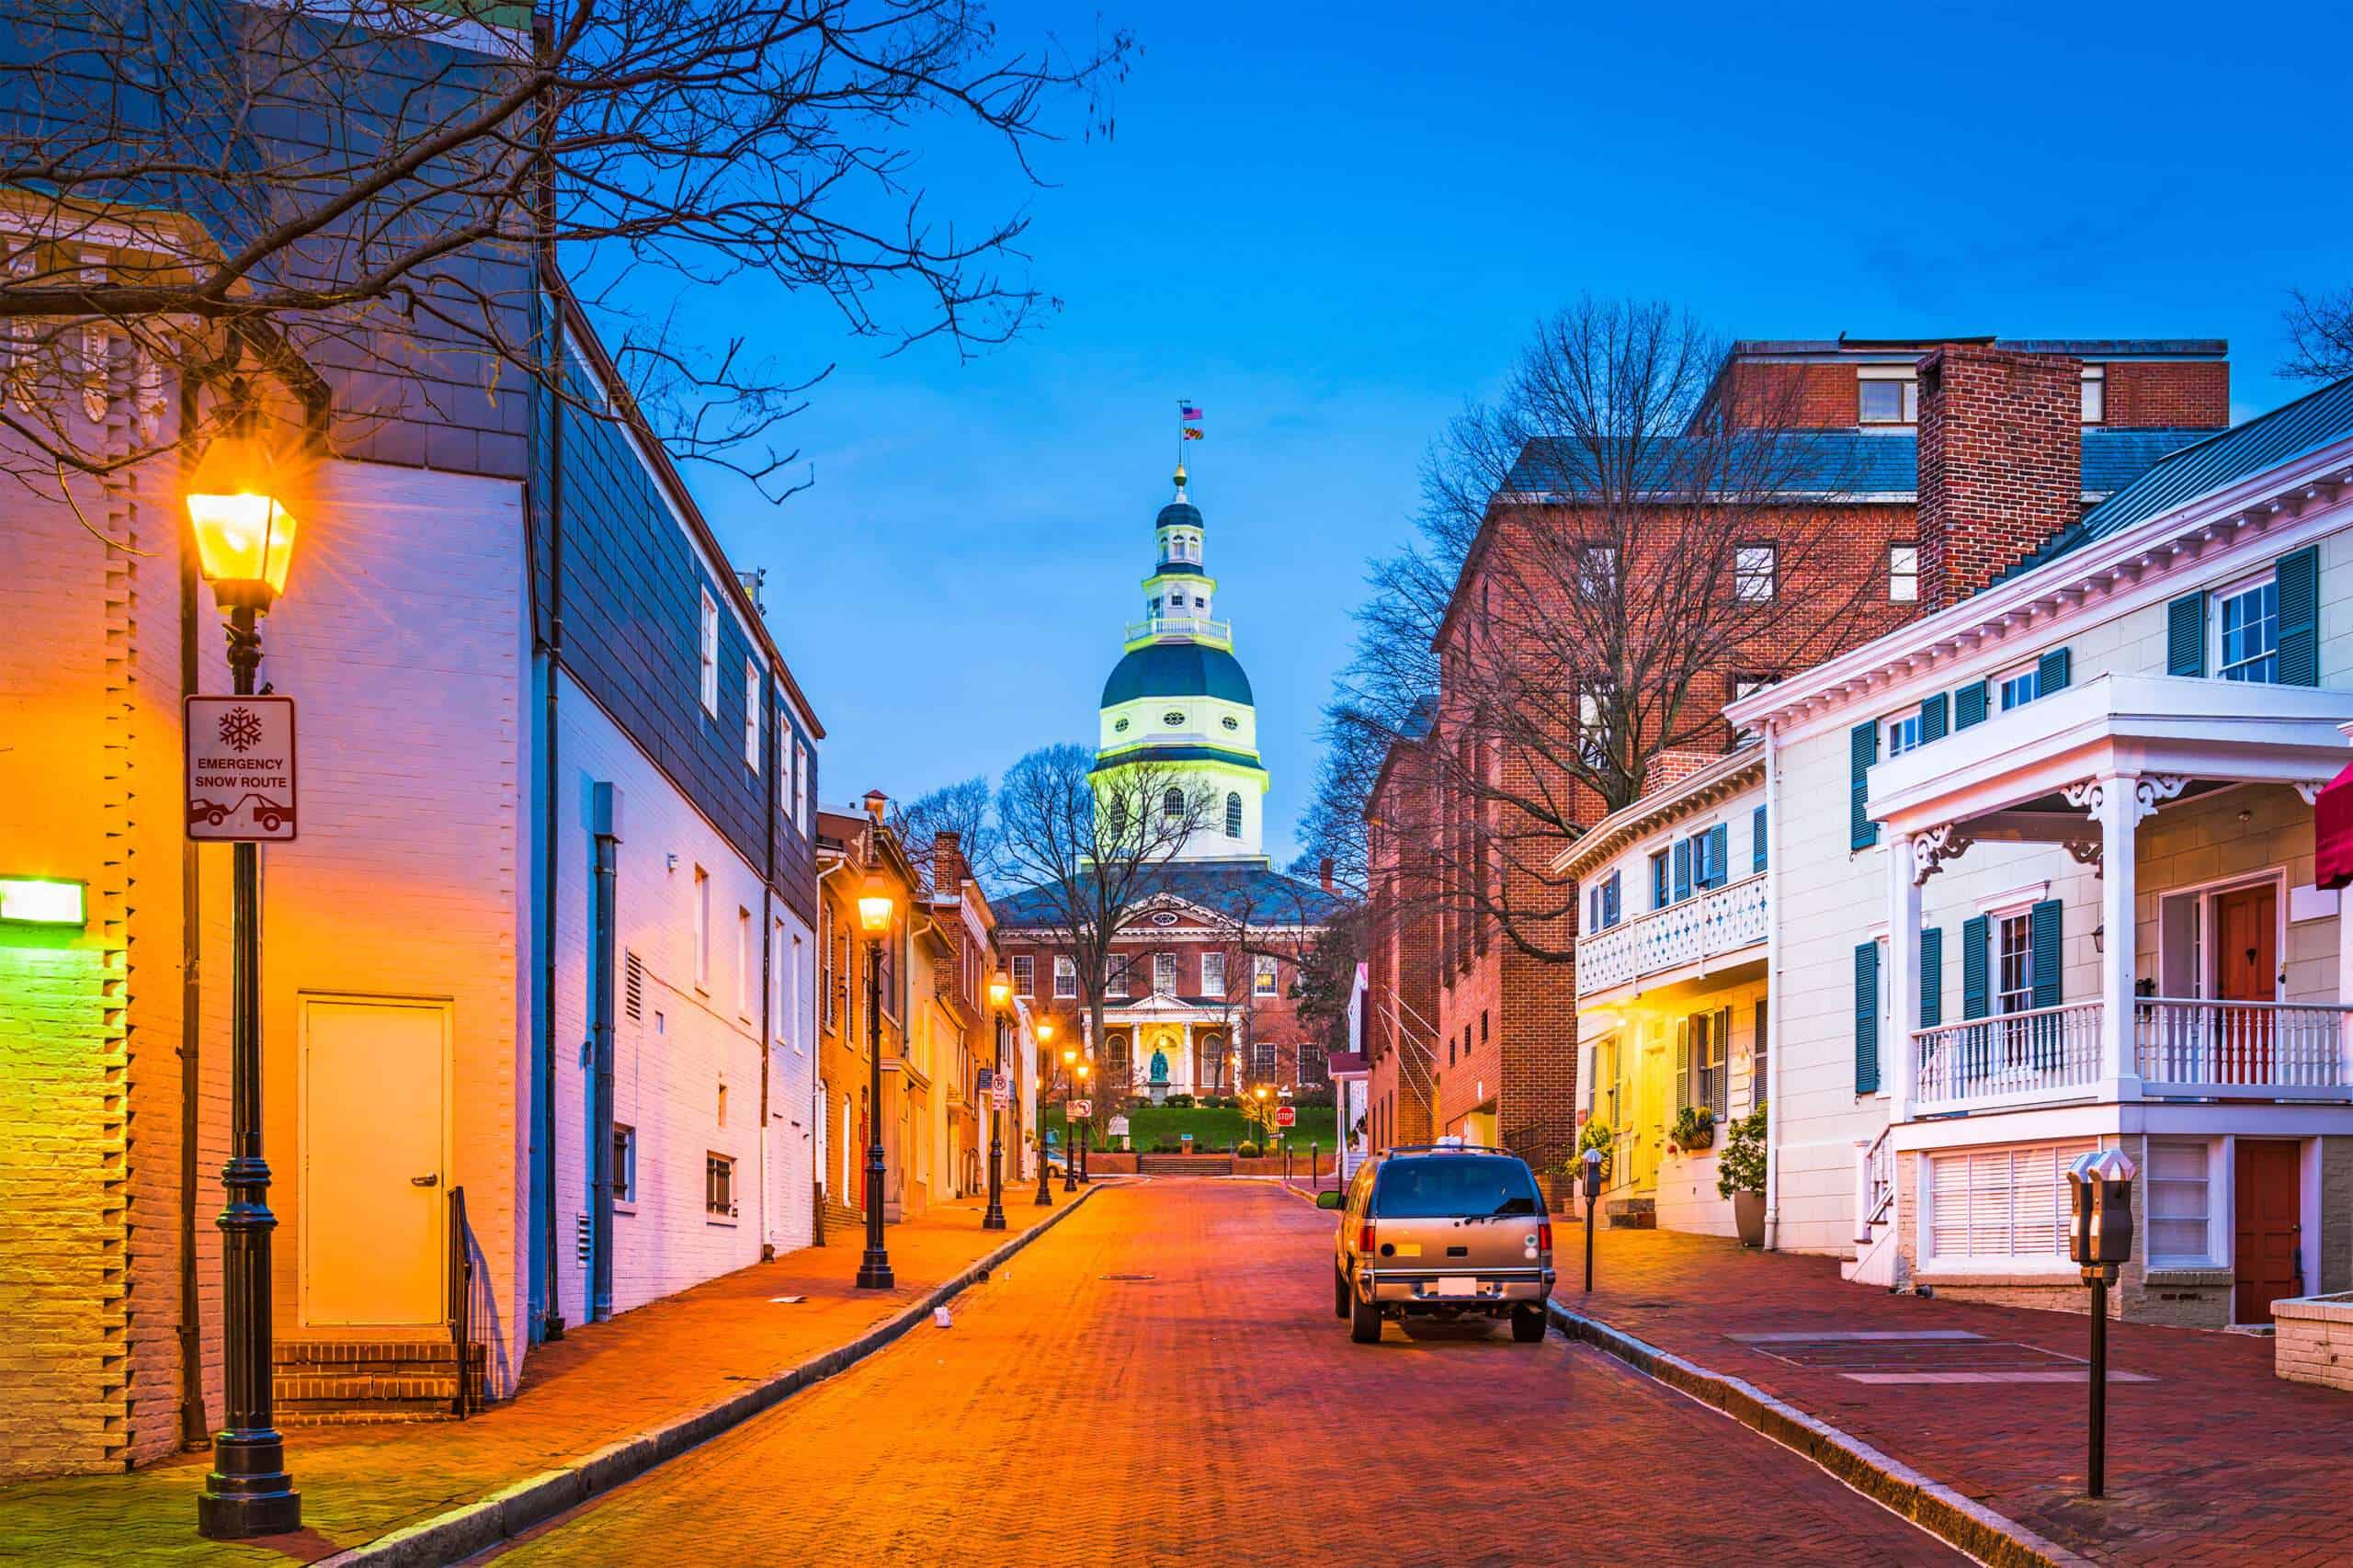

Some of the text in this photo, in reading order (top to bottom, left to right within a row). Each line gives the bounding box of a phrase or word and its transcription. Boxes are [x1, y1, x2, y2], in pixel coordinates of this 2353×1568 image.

[198, 758, 283, 769] EMERGENCY
[195, 777, 287, 788] SNOW ROUTE
